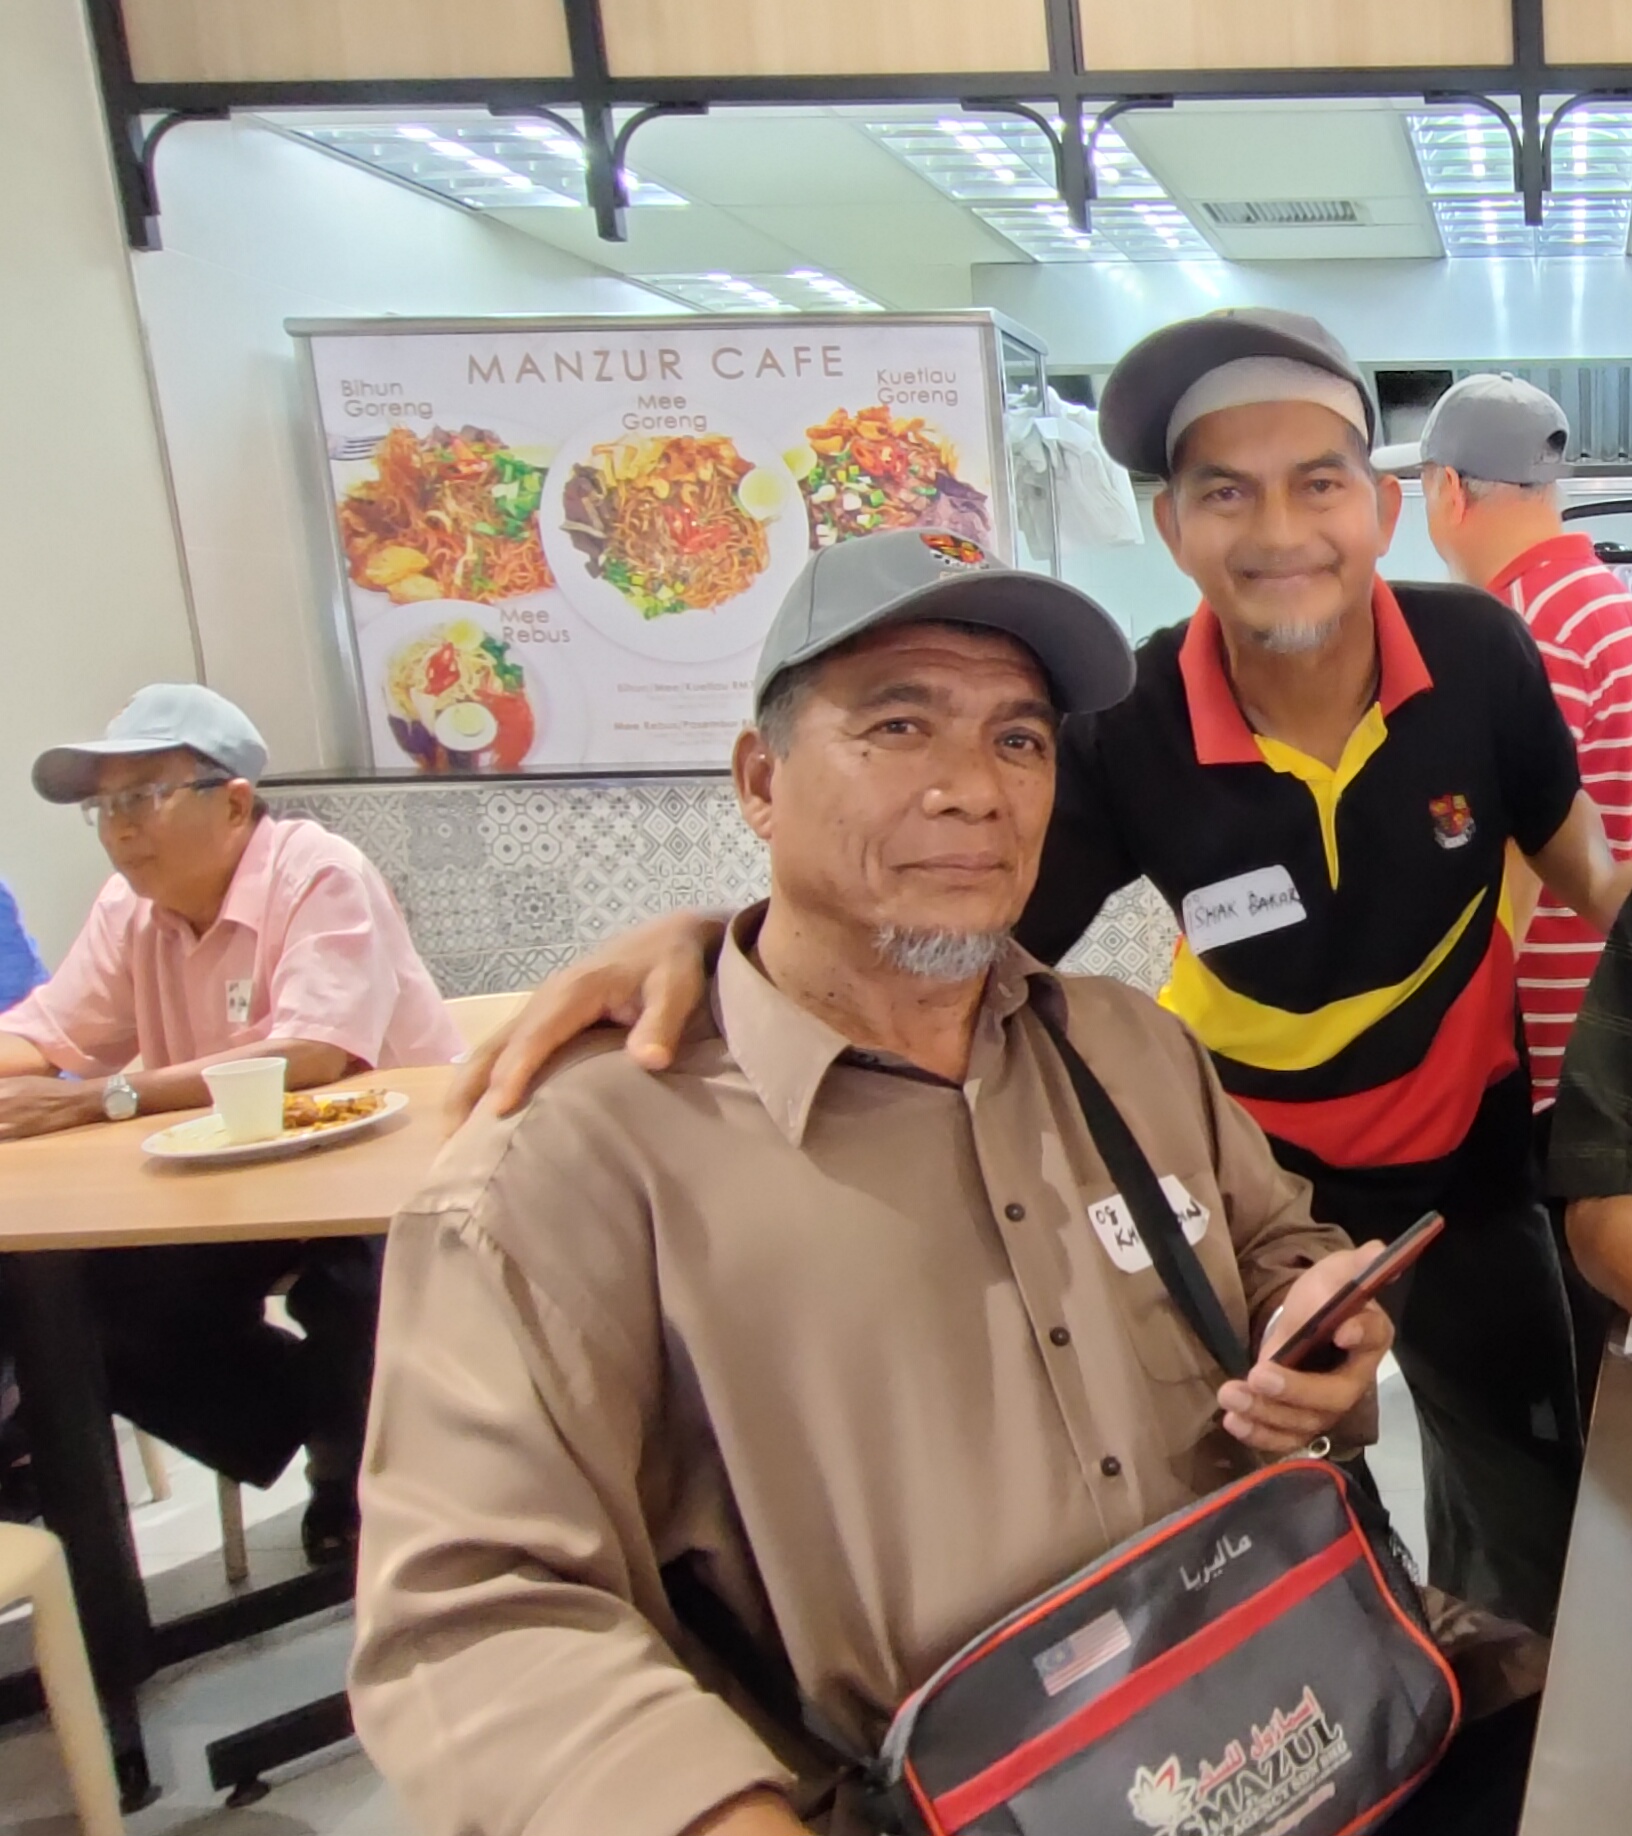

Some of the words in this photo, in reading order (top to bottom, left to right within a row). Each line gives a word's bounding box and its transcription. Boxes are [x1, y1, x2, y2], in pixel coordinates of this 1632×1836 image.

[467, 348, 683, 384] MANZUR
[711, 346, 843, 379] CAFE
[876, 367, 957, 385] Kuetiau
[341, 379, 404, 397] Bihun
[876, 387, 959, 406] Goreng
[344, 400, 433, 419] Goreng
[637, 394, 687, 410] Mee
[622, 413, 707, 432] Goreng
[501, 608, 550, 624] Mee
[502, 625, 571, 643] Rebus
